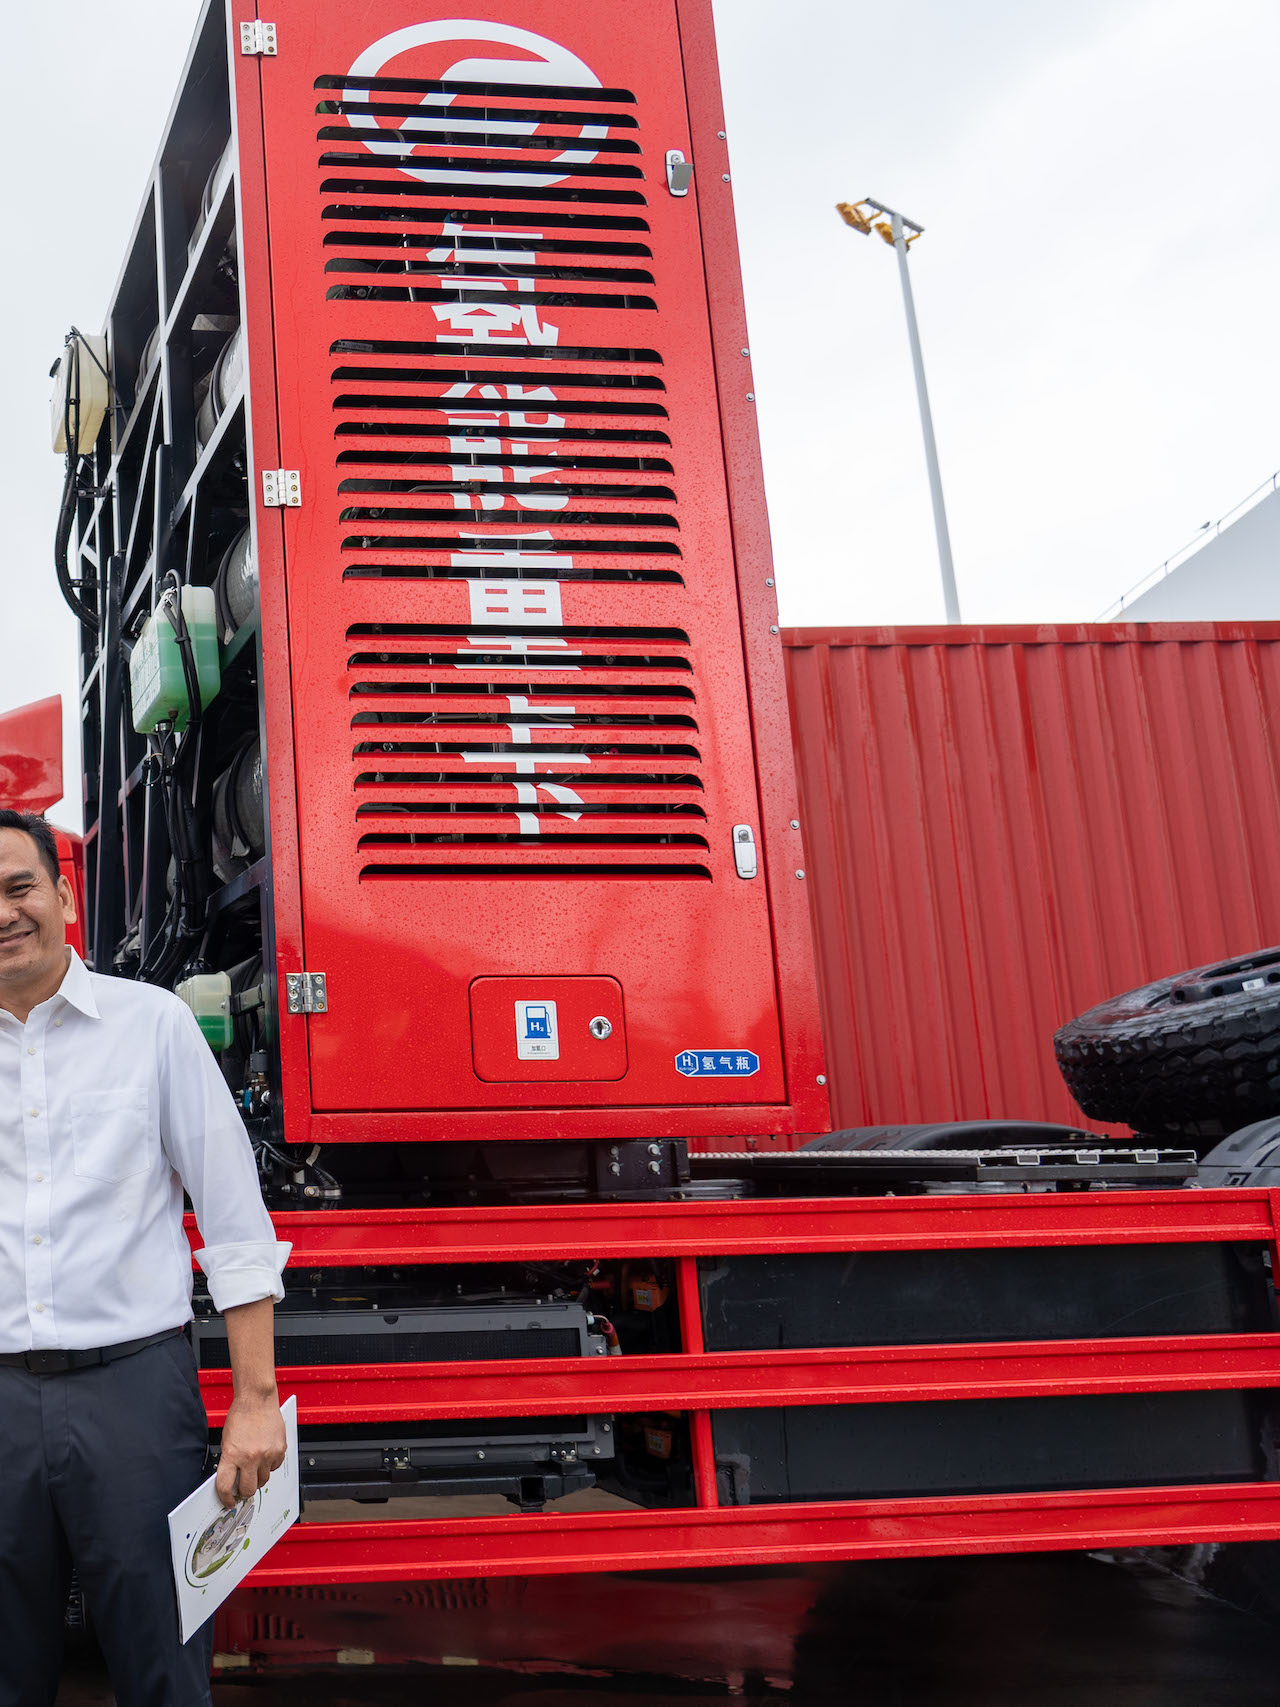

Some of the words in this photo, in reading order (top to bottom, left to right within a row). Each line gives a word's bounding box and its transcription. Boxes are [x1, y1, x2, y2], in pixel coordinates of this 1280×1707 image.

[425, 222, 592, 837] 氢能重卡
[702, 1055, 750, 1071] 氢气瓶
